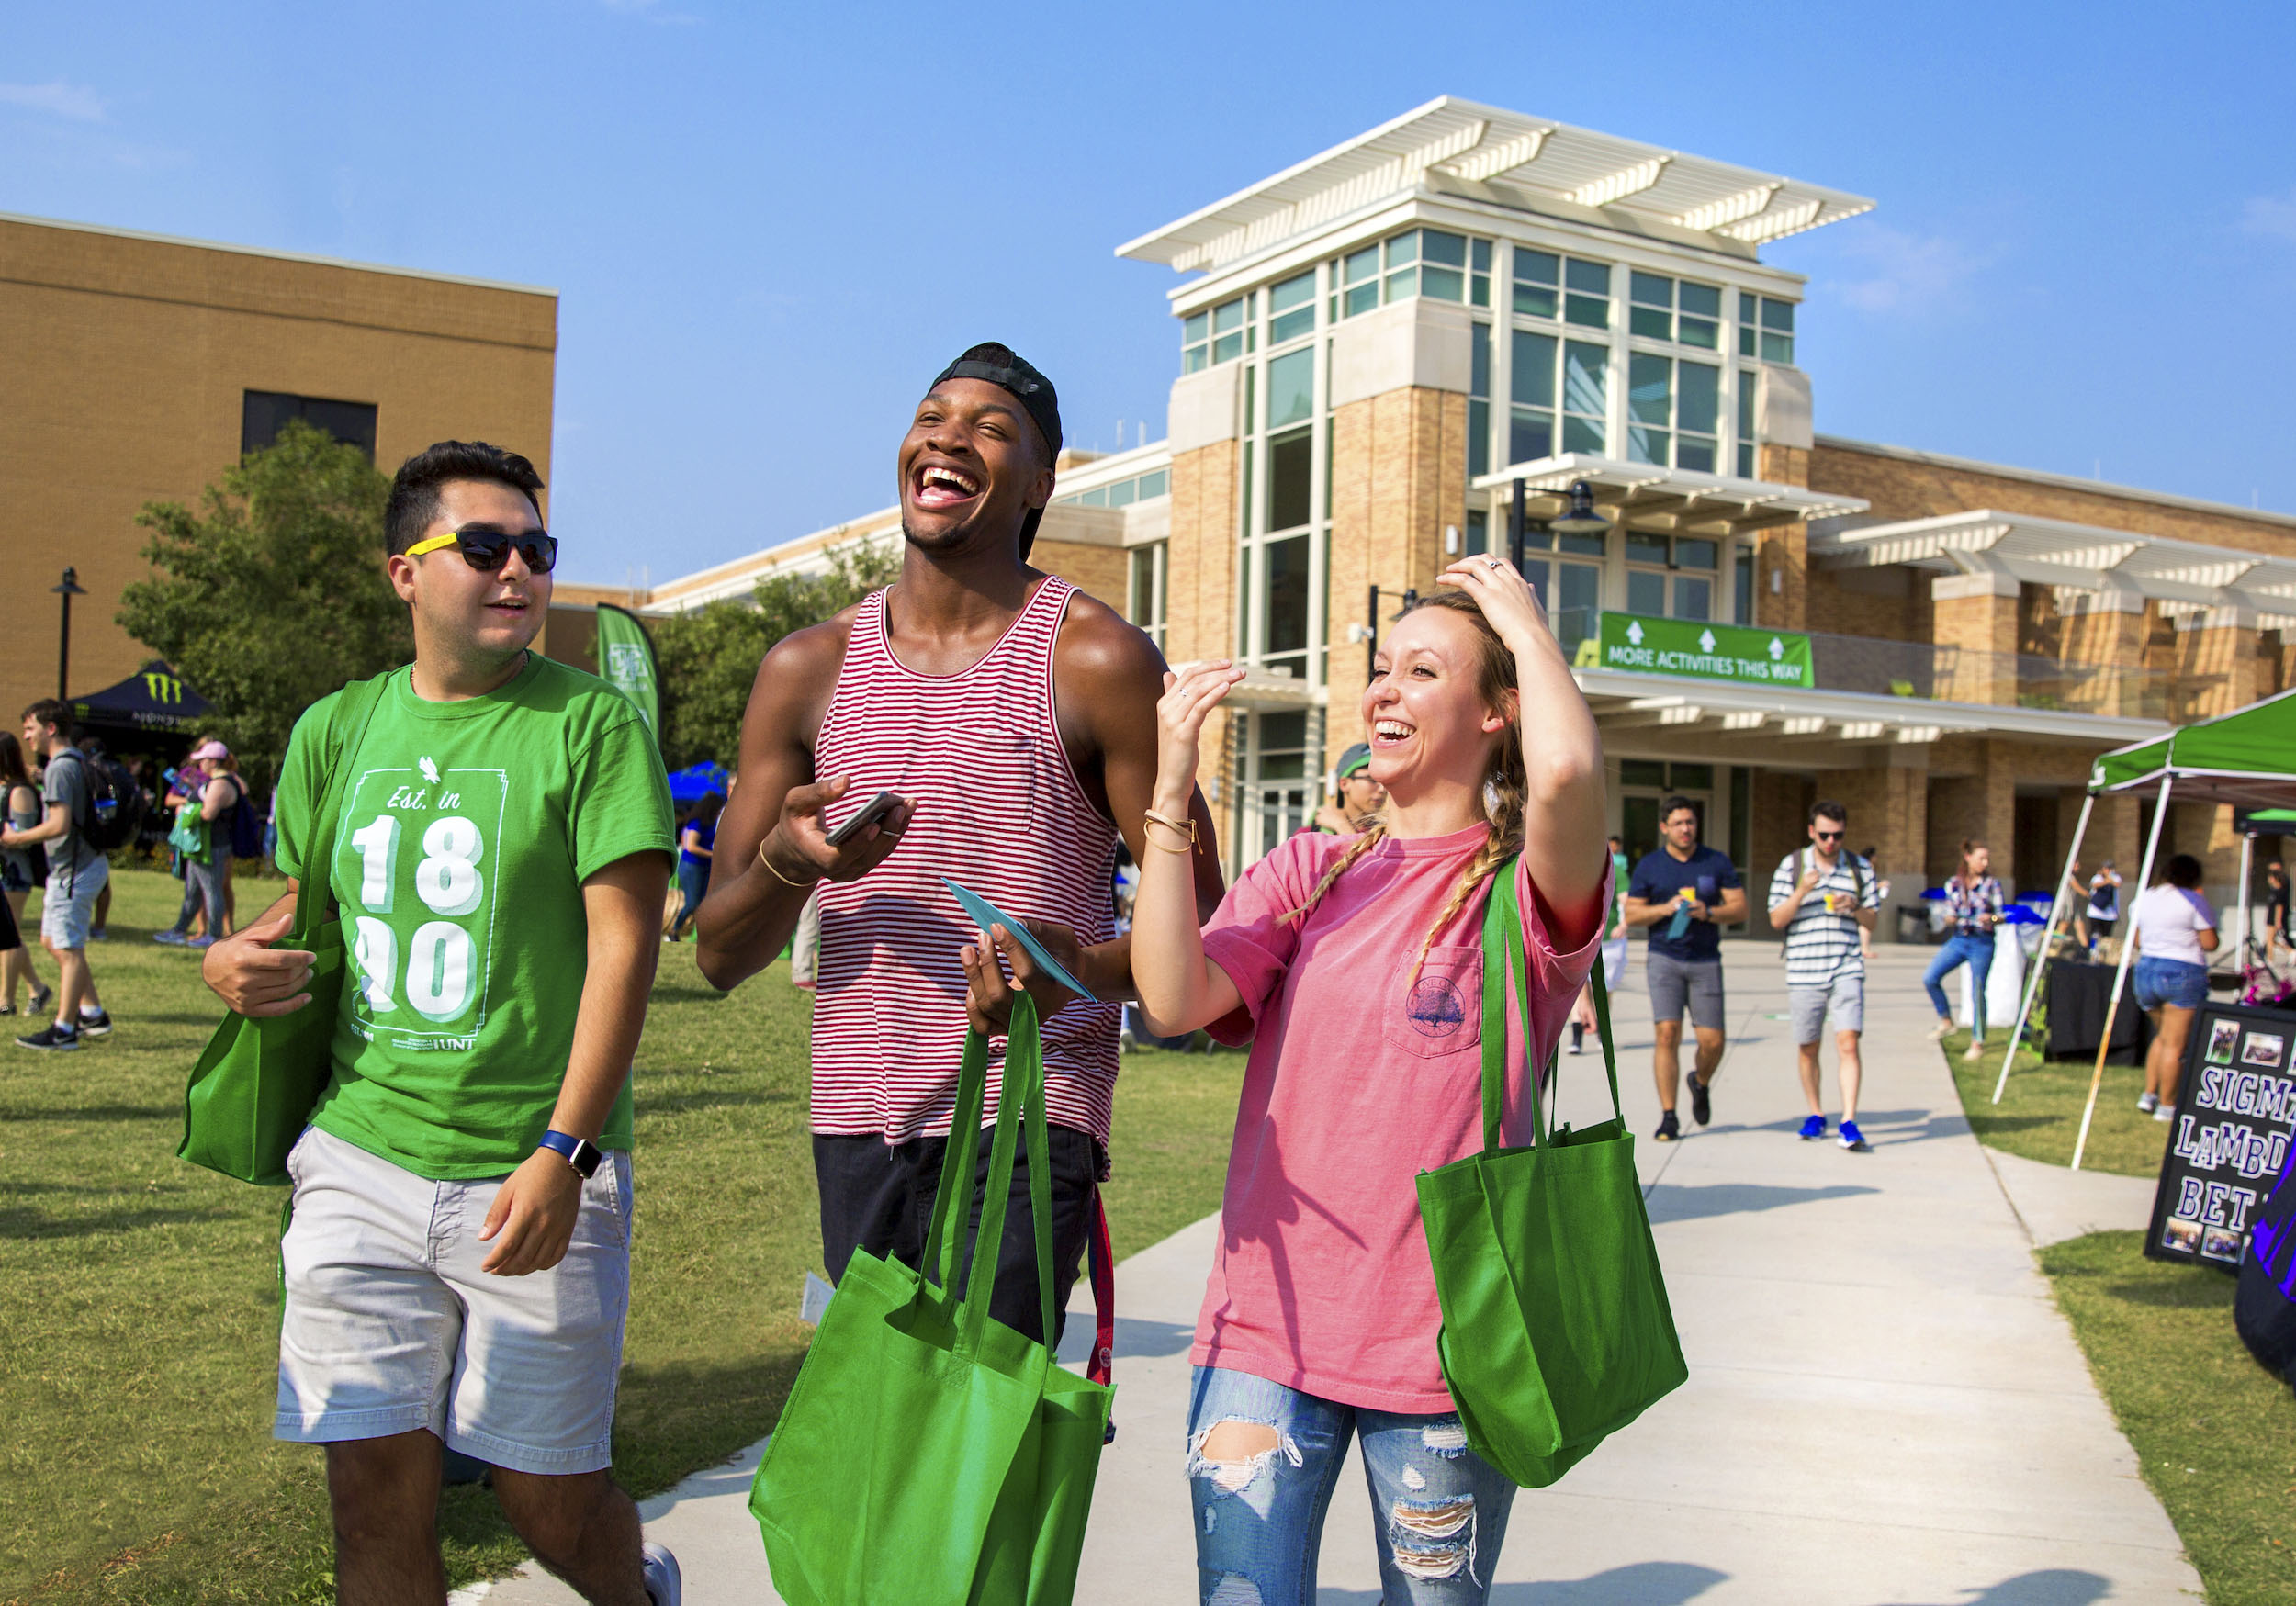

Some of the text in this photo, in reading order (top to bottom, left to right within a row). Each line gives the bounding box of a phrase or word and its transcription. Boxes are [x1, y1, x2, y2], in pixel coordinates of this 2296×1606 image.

[1608, 646, 1803, 680] MORE ACTIVITIES THIS WAY
[387, 785, 461, 809] Est. in
[351, 814, 484, 916] 18
[439, 1039, 477, 1050] UNT
[2173, 1114, 2294, 1179] LAMBD
